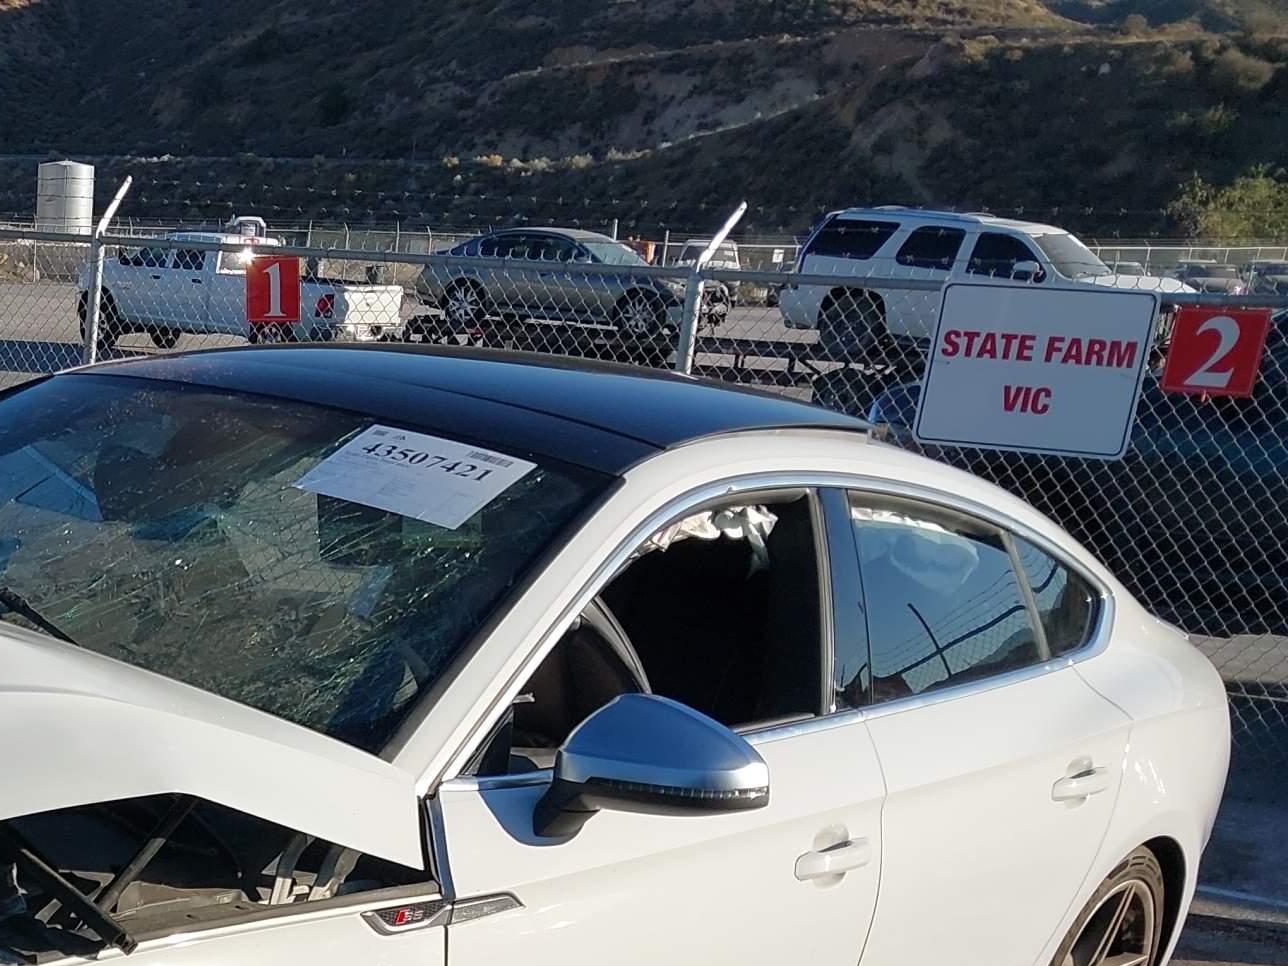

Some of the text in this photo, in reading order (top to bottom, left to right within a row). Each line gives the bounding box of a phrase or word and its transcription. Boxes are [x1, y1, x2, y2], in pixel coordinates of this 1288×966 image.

[262, 262, 288, 317] 1
[941, 329, 1139, 369] STATE FARM
[1183, 315, 1241, 389] 2
[1002, 384, 1053, 415] VIC
[362, 442, 494, 482] 43507421
